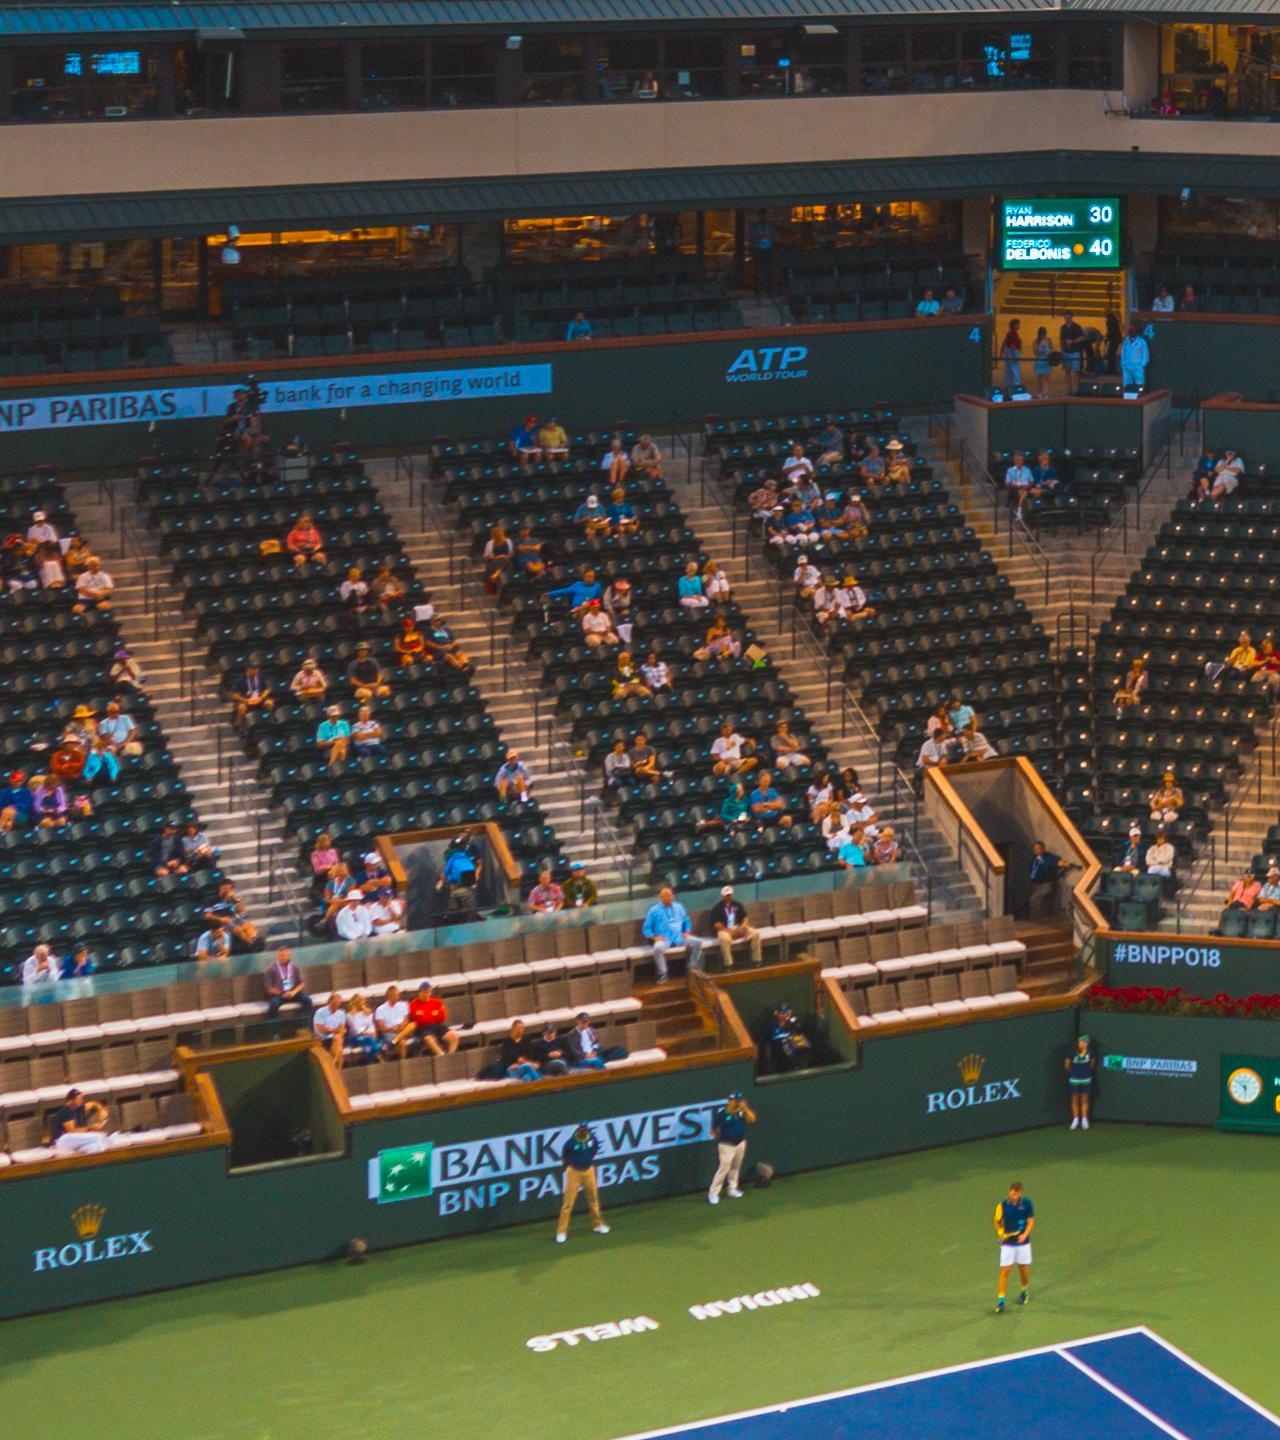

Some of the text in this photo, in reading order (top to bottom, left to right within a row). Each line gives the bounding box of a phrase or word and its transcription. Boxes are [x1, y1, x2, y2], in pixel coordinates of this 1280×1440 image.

[1006, 206, 1112, 223] RYAN 30
[1006, 215, 1074, 227] HARRISON
[1006, 248, 1072, 260] DELBONIS
[1089, 239, 1112, 256] 40
[968, 327, 981, 343] 4
[1143, 324, 1155, 339] 4
[727, 346, 809, 373] ATP
[274, 385, 322, 404] bank
[326, 384, 355, 405] for
[361, 386, 371, 398] a
[377, 376, 463, 396] changing
[468, 372, 522, 390] world
[726, 369, 809, 383] WORLD TOUR
[52, 392, 177, 424] PARIBAS
[1113, 944, 1221, 967] #BNPPO18
[926, 1078, 1022, 1113] ROLEX
[439, 1130, 563, 1182] BANK
[438, 1153, 661, 1216] BNP PABAS
[32, 1228, 154, 1272] ROLEX
[526, 1282, 820, 1352] INDIAN WELLS
